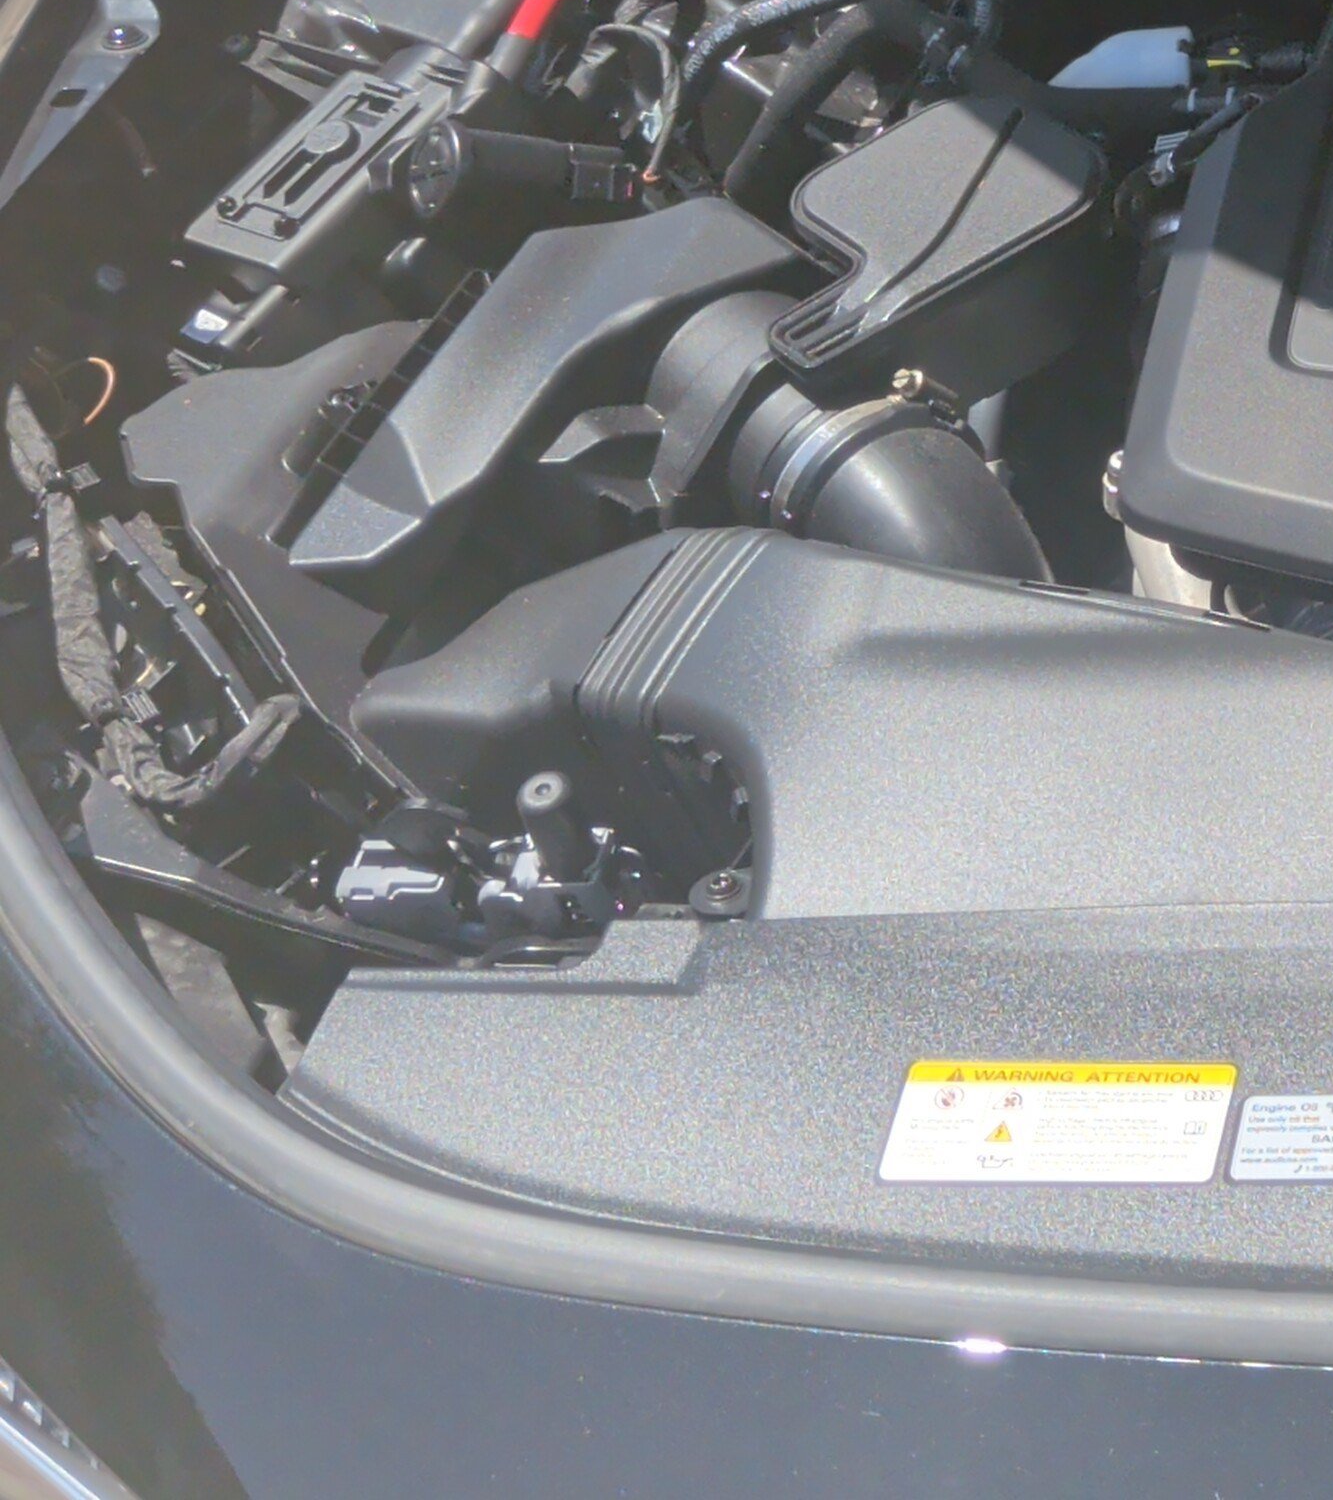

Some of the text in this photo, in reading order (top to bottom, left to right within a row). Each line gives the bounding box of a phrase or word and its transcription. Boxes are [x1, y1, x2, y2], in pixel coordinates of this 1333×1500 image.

[974, 1070, 1201, 1083] WARNING ATTENTION
[1252, 1104, 1296, 1113] Engine
